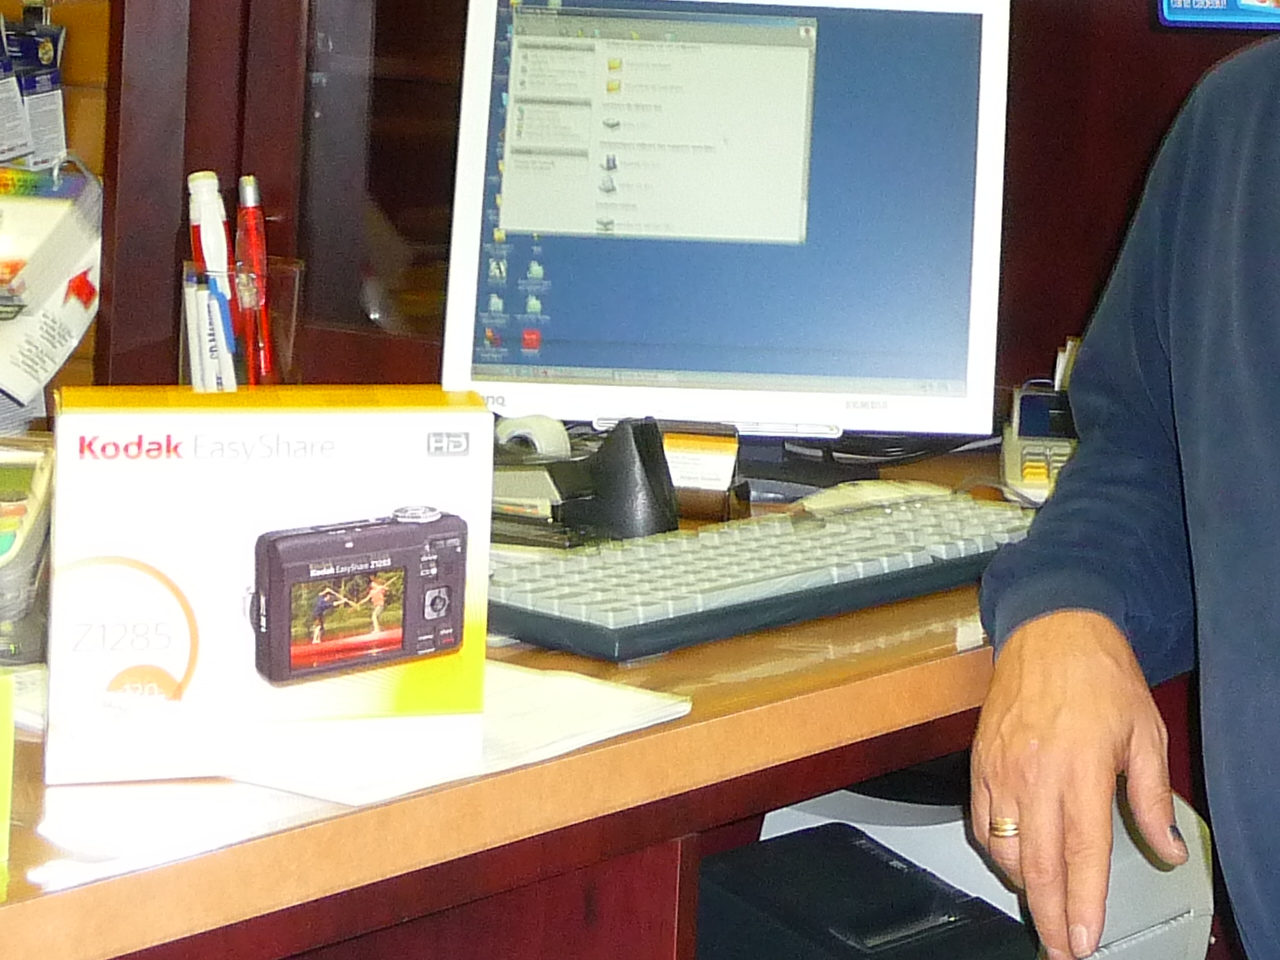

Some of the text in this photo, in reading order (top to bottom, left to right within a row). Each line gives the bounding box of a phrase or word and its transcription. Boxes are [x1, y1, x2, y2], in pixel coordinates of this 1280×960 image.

[78, 433, 335, 464] Kodak EasyShare
[429, 434, 468, 453] HD
[72, 622, 172, 652] Z1285
